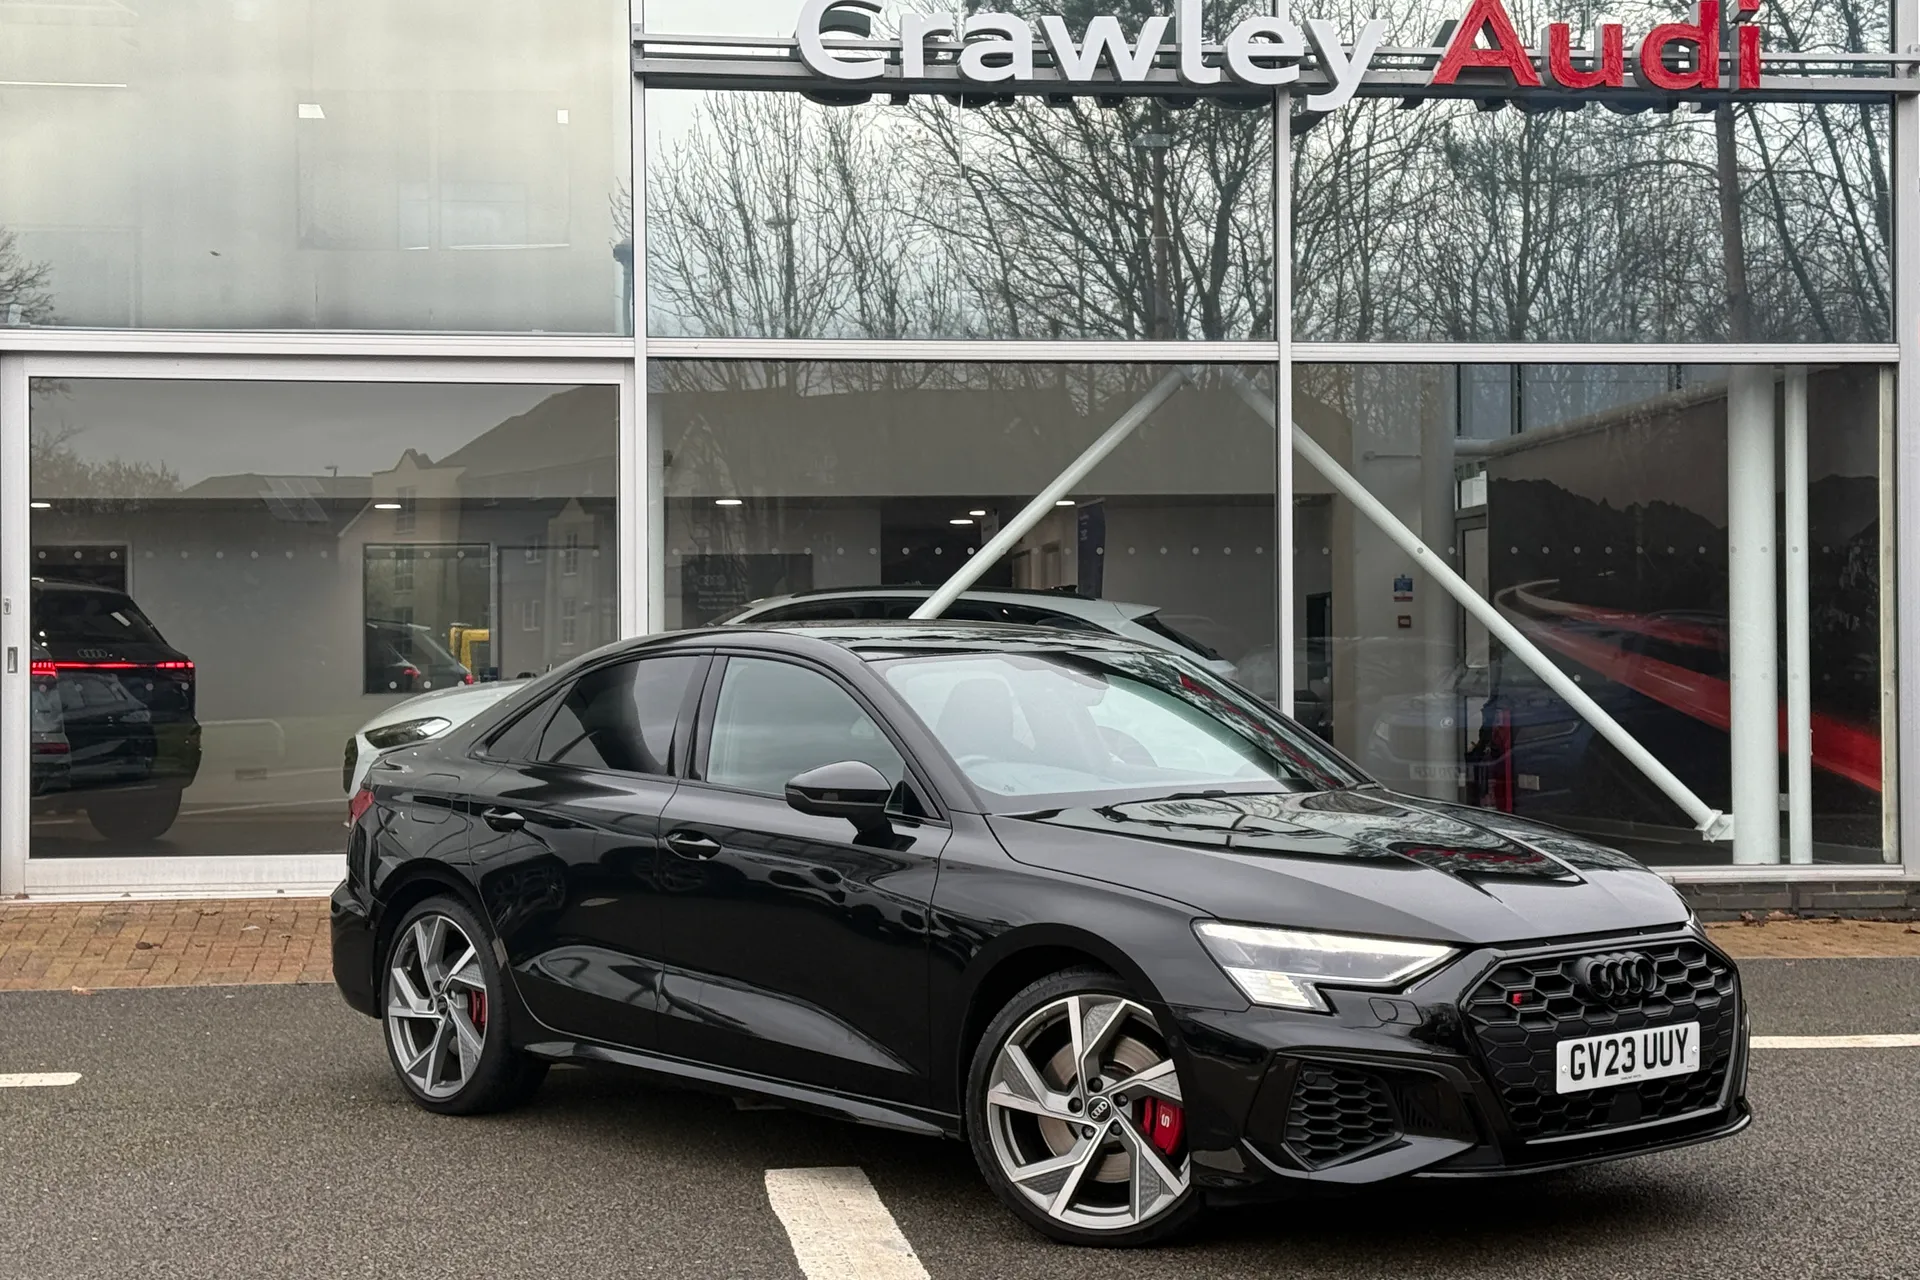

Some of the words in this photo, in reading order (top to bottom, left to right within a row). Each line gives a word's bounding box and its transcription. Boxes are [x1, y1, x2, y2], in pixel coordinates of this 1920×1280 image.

[796, 0, 1385, 111] Crawley
[1431, 0, 1761, 91] Audi
[1570, 1036, 1636, 1081] GV23
[1643, 1027, 1689, 1070] UUY
[1161, 1113, 1170, 1128] S
